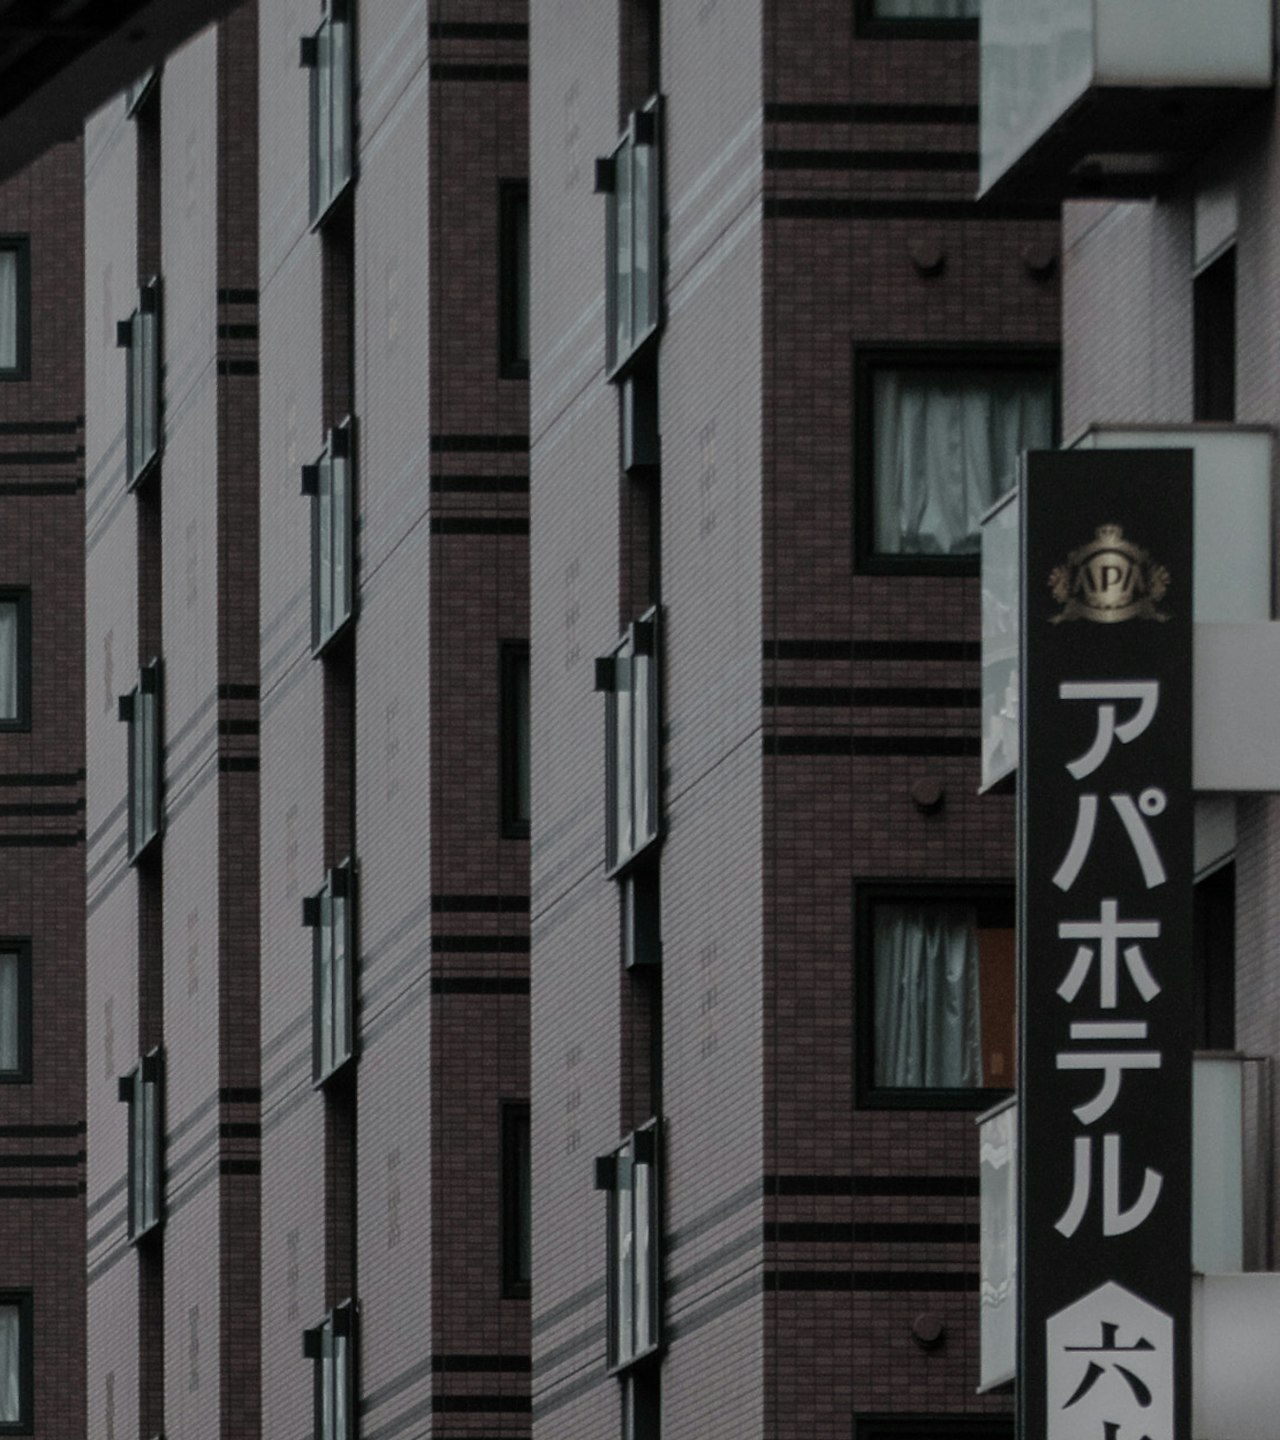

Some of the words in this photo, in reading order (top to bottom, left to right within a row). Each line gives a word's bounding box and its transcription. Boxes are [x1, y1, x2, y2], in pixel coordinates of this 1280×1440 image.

[1052, 680, 1168, 1240] アパホテル
